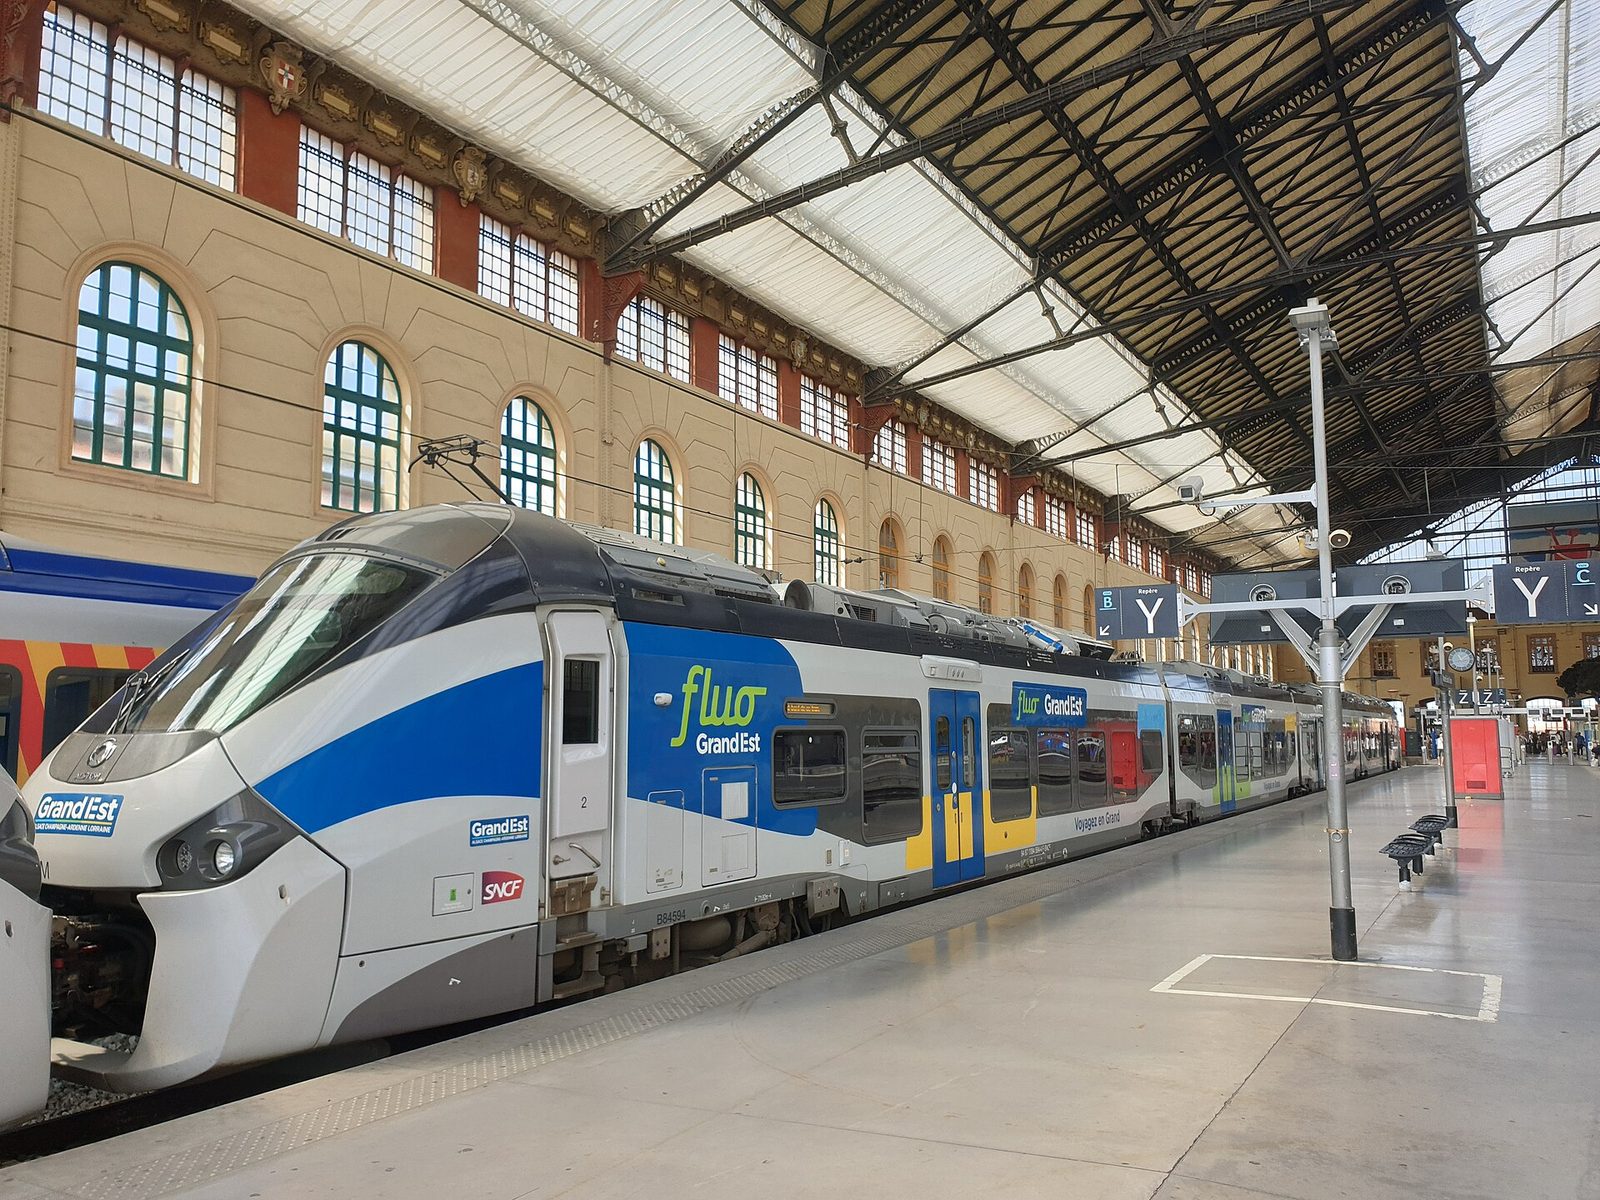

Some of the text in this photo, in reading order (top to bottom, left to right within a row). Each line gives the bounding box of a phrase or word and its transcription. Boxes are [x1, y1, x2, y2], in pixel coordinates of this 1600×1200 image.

[1515, 566, 1541, 574] Repère
[1576, 569, 1590, 583] C
[1103, 597, 1113, 608] B
[1512, 576, 1549, 617] Y
[1135, 597, 1164, 634] Y
[670, 664, 767, 747] fluo
[1016, 690, 1040, 721] fluo
[1458, 692, 1469, 704] Z
[1483, 692, 1494, 704] Z
[581, 796, 588, 809] 2
[1074, 809, 1121, 832] Voyagez en Grand
[483, 878, 522, 900] SNCF
[656, 909, 687, 925] B84594
